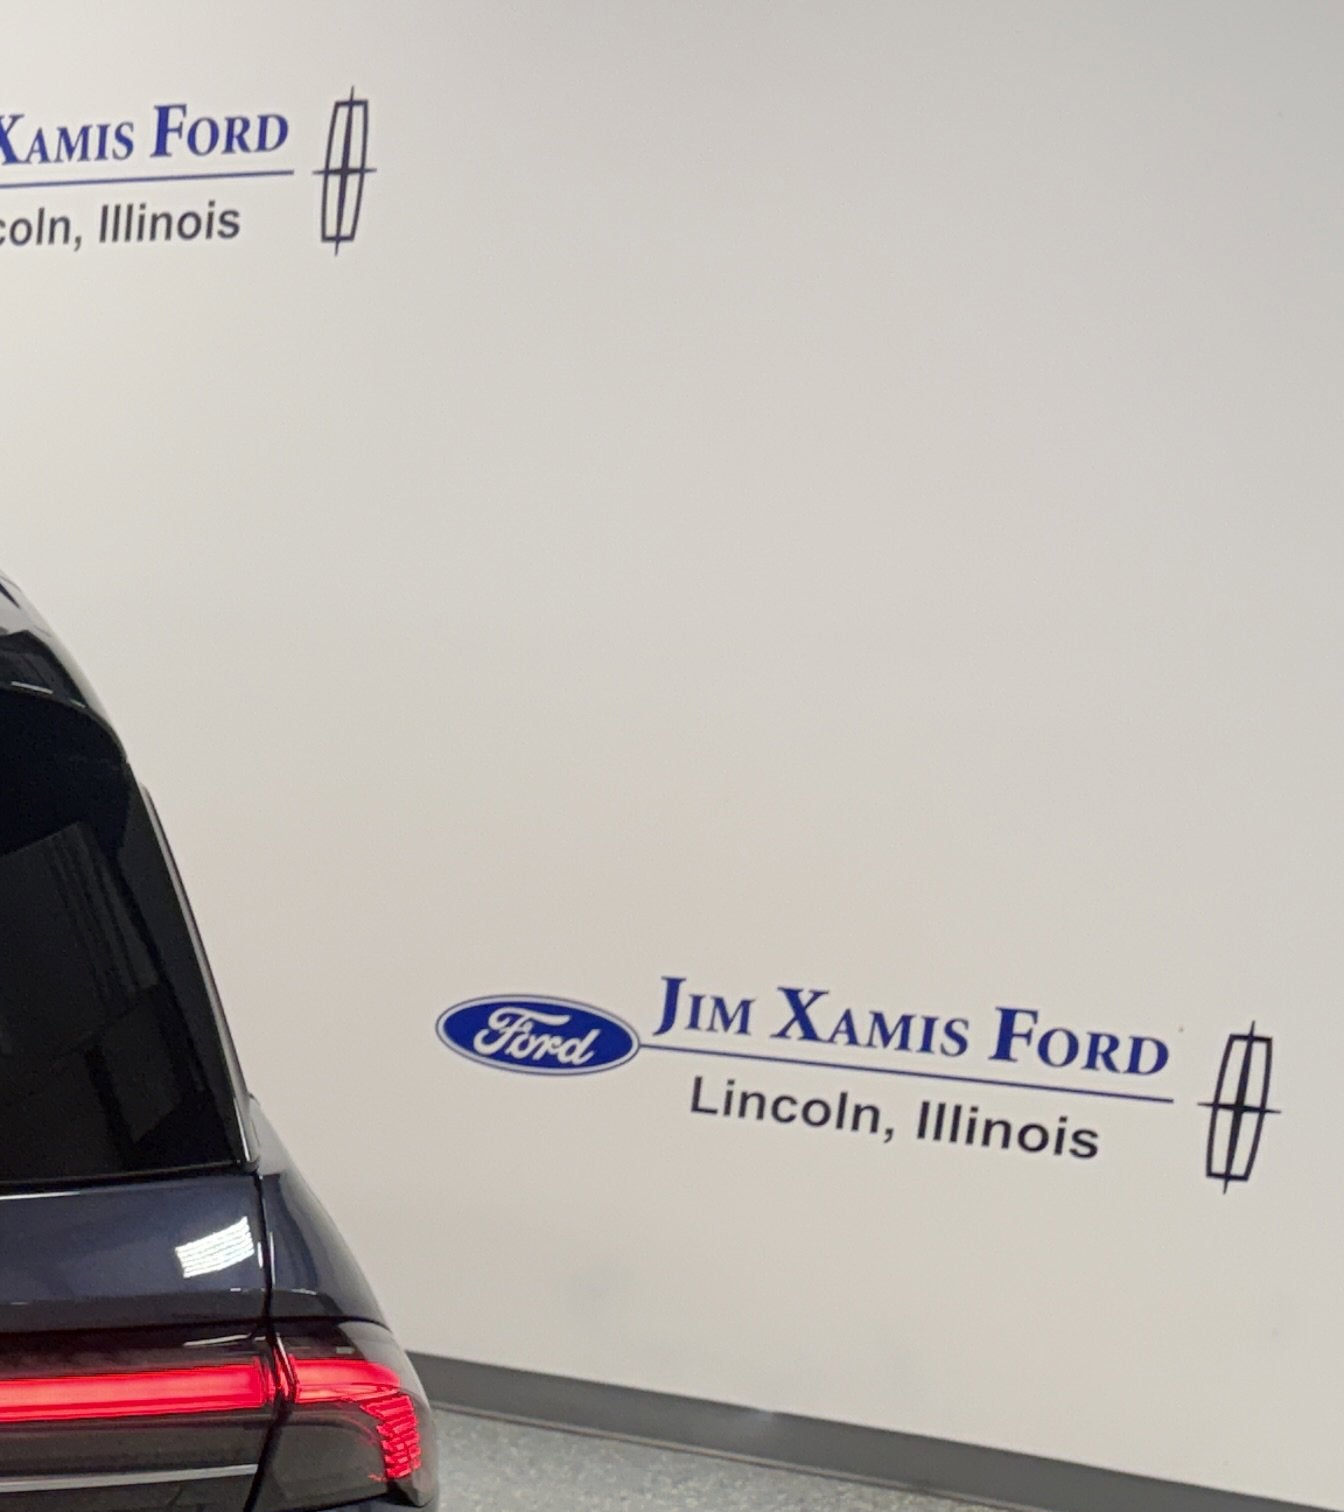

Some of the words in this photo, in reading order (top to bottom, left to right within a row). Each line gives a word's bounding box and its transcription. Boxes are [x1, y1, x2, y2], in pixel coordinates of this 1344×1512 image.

[150, 104, 288, 158] FORD
[99, 200, 240, 243] Illinois
[473, 1008, 595, 1066] Ford
[654, 976, 756, 1036] JIM
[770, 986, 970, 1058] XAMIS
[988, 1006, 1170, 1077] FORD
[691, 1076, 894, 1141] Lincoln,
[917, 1101, 1099, 1159] Illinois
